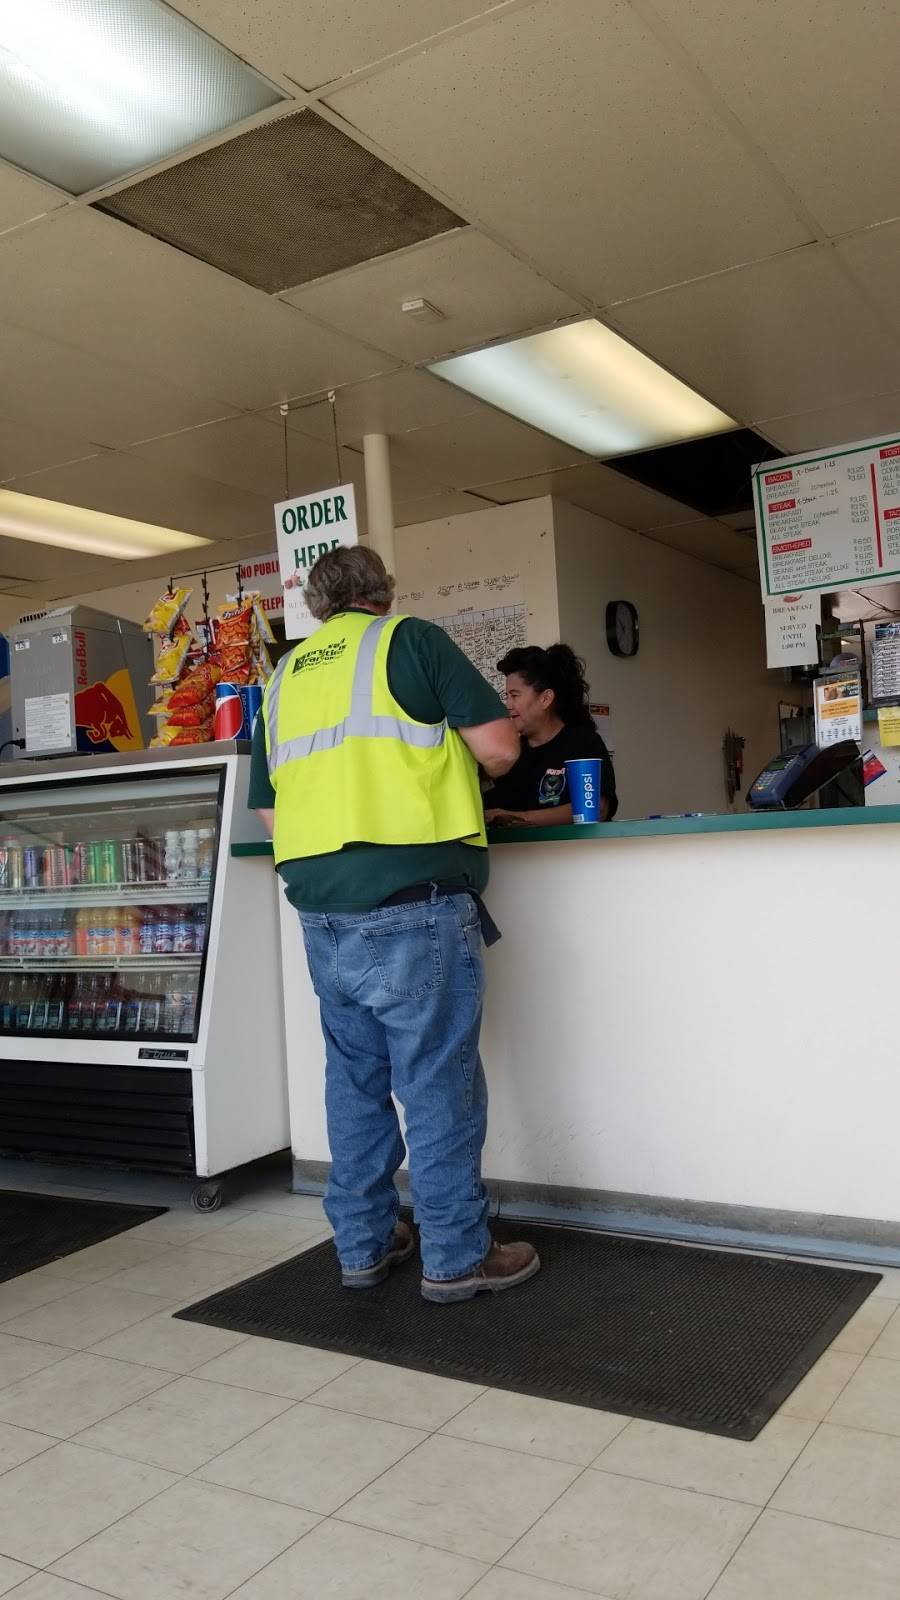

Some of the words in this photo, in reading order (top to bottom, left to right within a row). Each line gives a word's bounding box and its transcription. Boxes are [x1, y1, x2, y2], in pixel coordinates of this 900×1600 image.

[885, 447, 900, 457] TOST
[768, 473, 790, 483] BACON
[766, 481, 800, 492] BREAKFAST
[767, 488, 800, 500] BREAKFAST
[848, 473, 865, 481] $3.50
[771, 501, 792, 511] STEAK
[282, 495, 348, 534] ORDER
[769, 509, 802, 521] BREAKFAST
[769, 516, 803, 528] BREAKFAST
[801, 520, 820, 529] STEAK
[783, 529, 803, 538] STEAK
[773, 540, 811, 553] SMOTHERED
[772, 551, 806, 562] BREAKFAST
[772, 558, 806, 568] BREAKFAST
[808, 561, 828, 570] STEAK
[240, 565, 252, 579] NO
[254, 560, 279, 576] PUBLI
[774, 573, 791, 582] BEAN
[805, 567, 824, 577] STEAK
[787, 577, 806, 586] STEAK
[773, 604, 812, 613] BREAKFAST
[581, 773, 595, 809] pepsi
